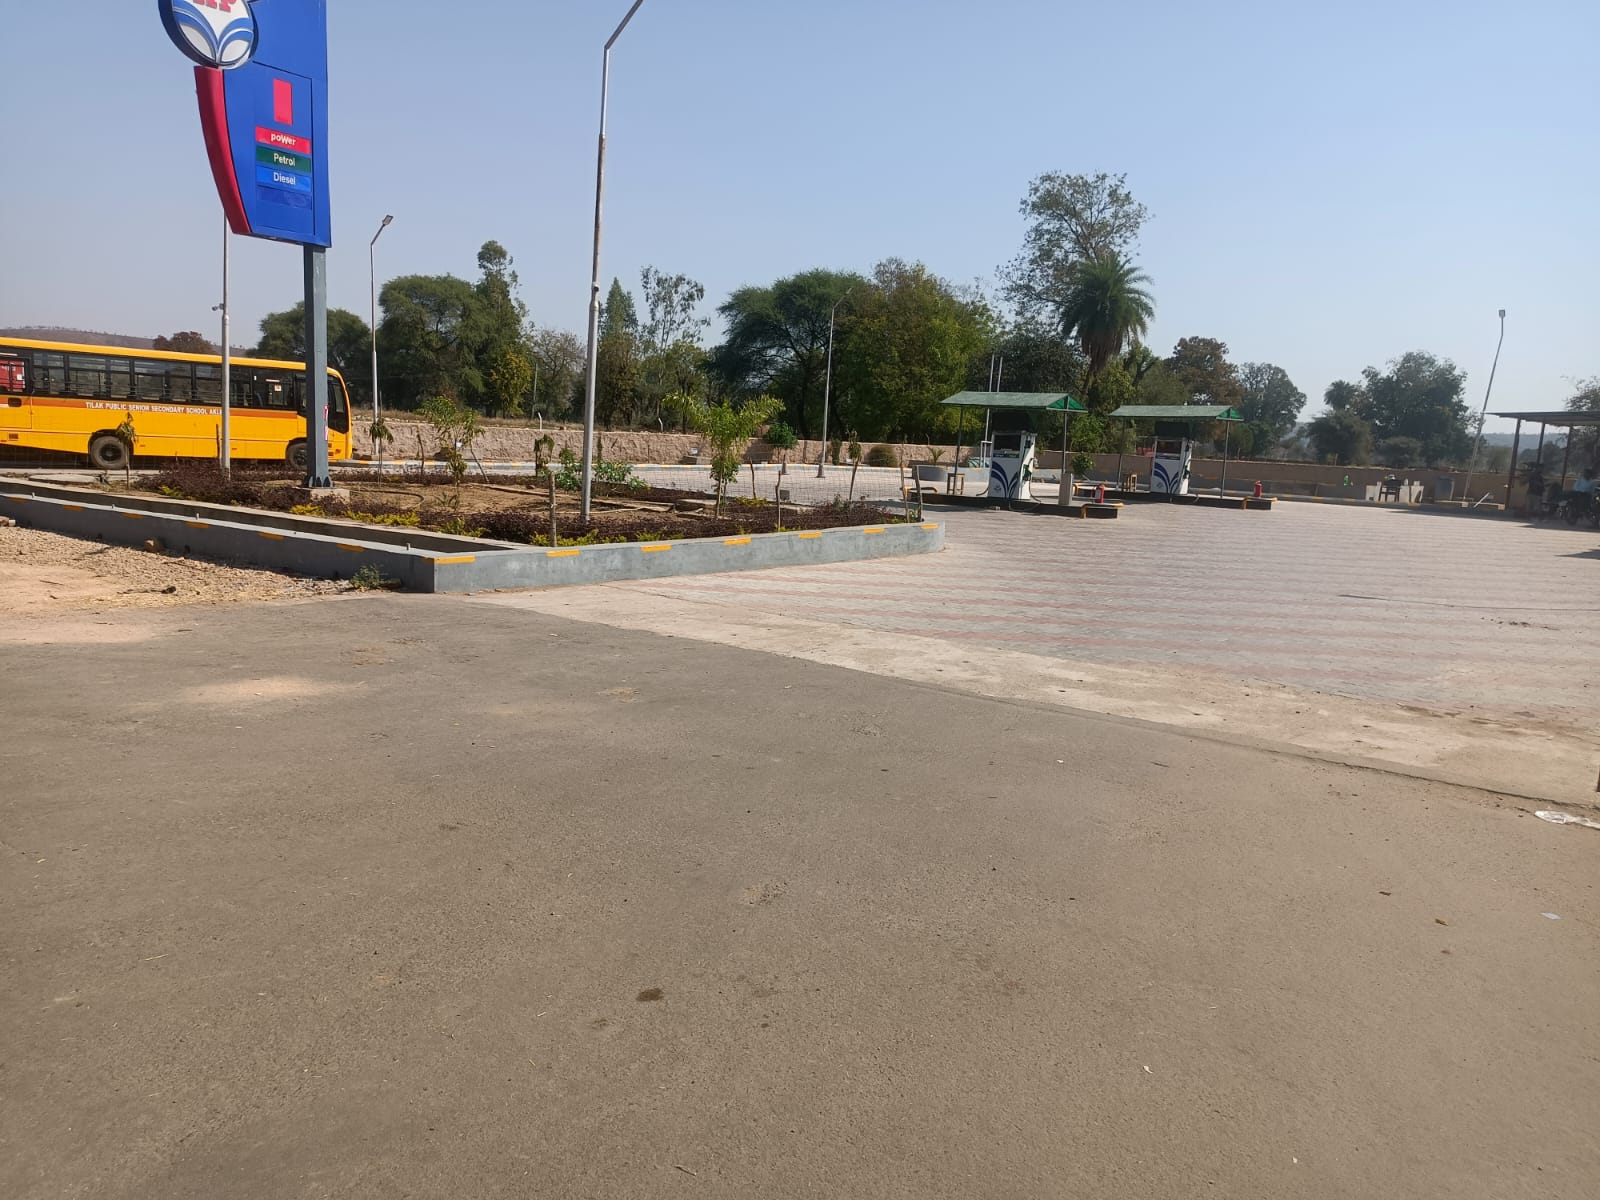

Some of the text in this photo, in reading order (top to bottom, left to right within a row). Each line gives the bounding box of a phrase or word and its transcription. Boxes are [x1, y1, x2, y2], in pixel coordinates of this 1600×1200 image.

[273, 152, 296, 166] Petrol
[273, 171, 296, 186] Diesel
[106, 402, 127, 410] PUBLIC
[151, 405, 184, 414] SECONDARY
